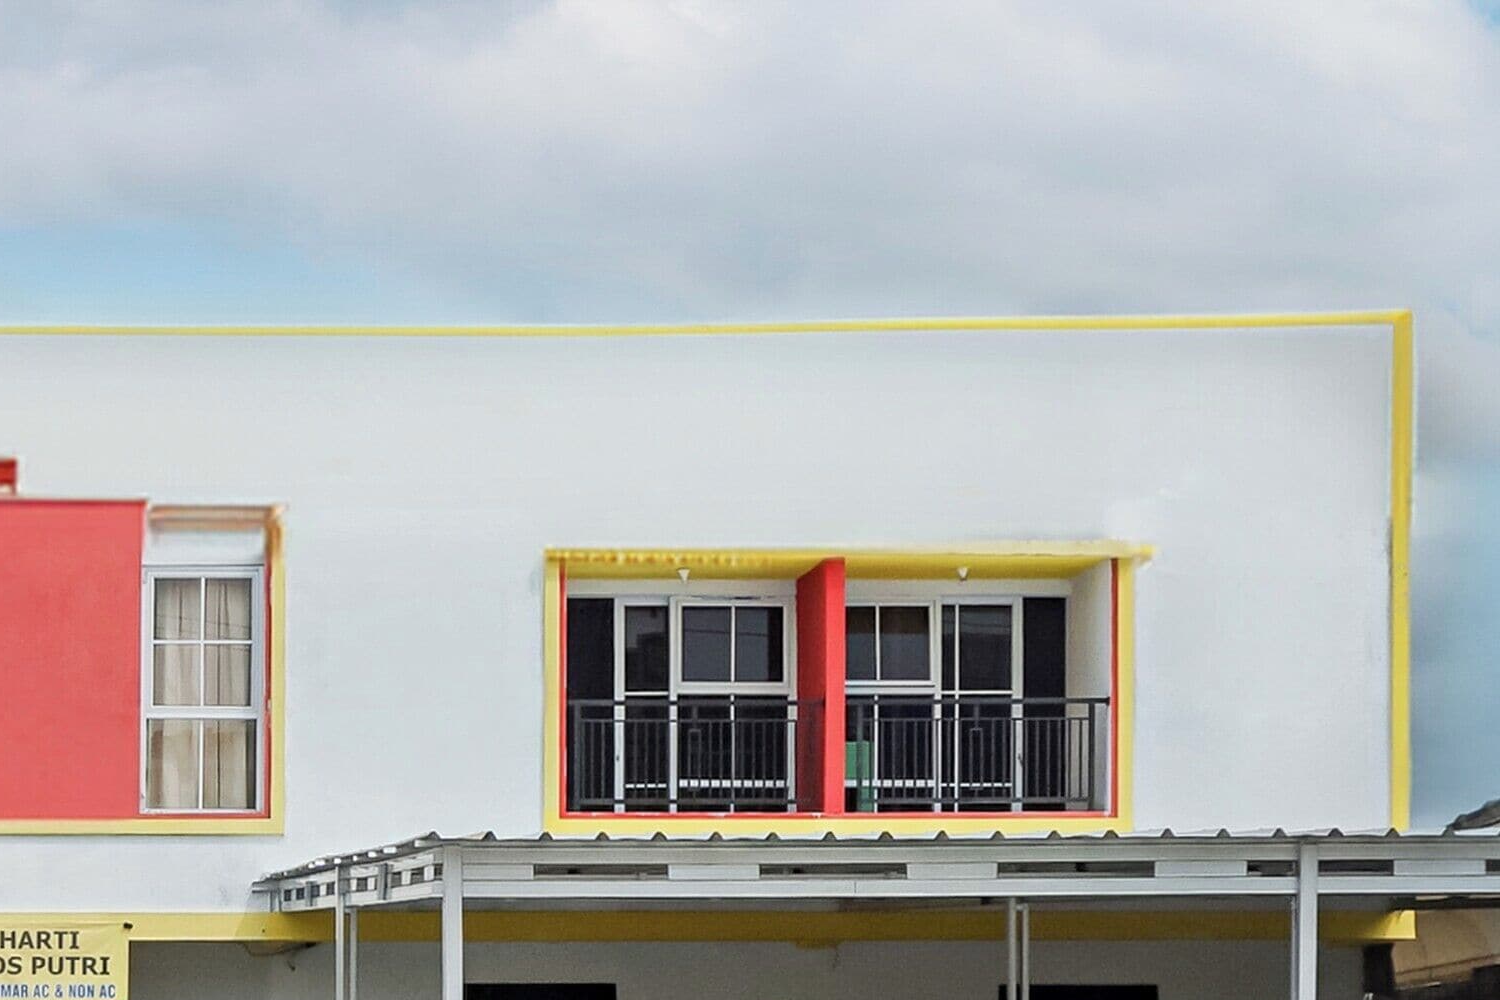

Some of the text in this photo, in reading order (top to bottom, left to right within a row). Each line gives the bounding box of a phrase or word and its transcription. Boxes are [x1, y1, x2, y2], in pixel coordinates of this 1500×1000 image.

[31, 955, 111, 975] PUTRI
[33, 983, 50, 998] AC
[55, 984, 64, 998] &
[68, 983, 95, 998] NON
[99, 983, 116, 998] AC
